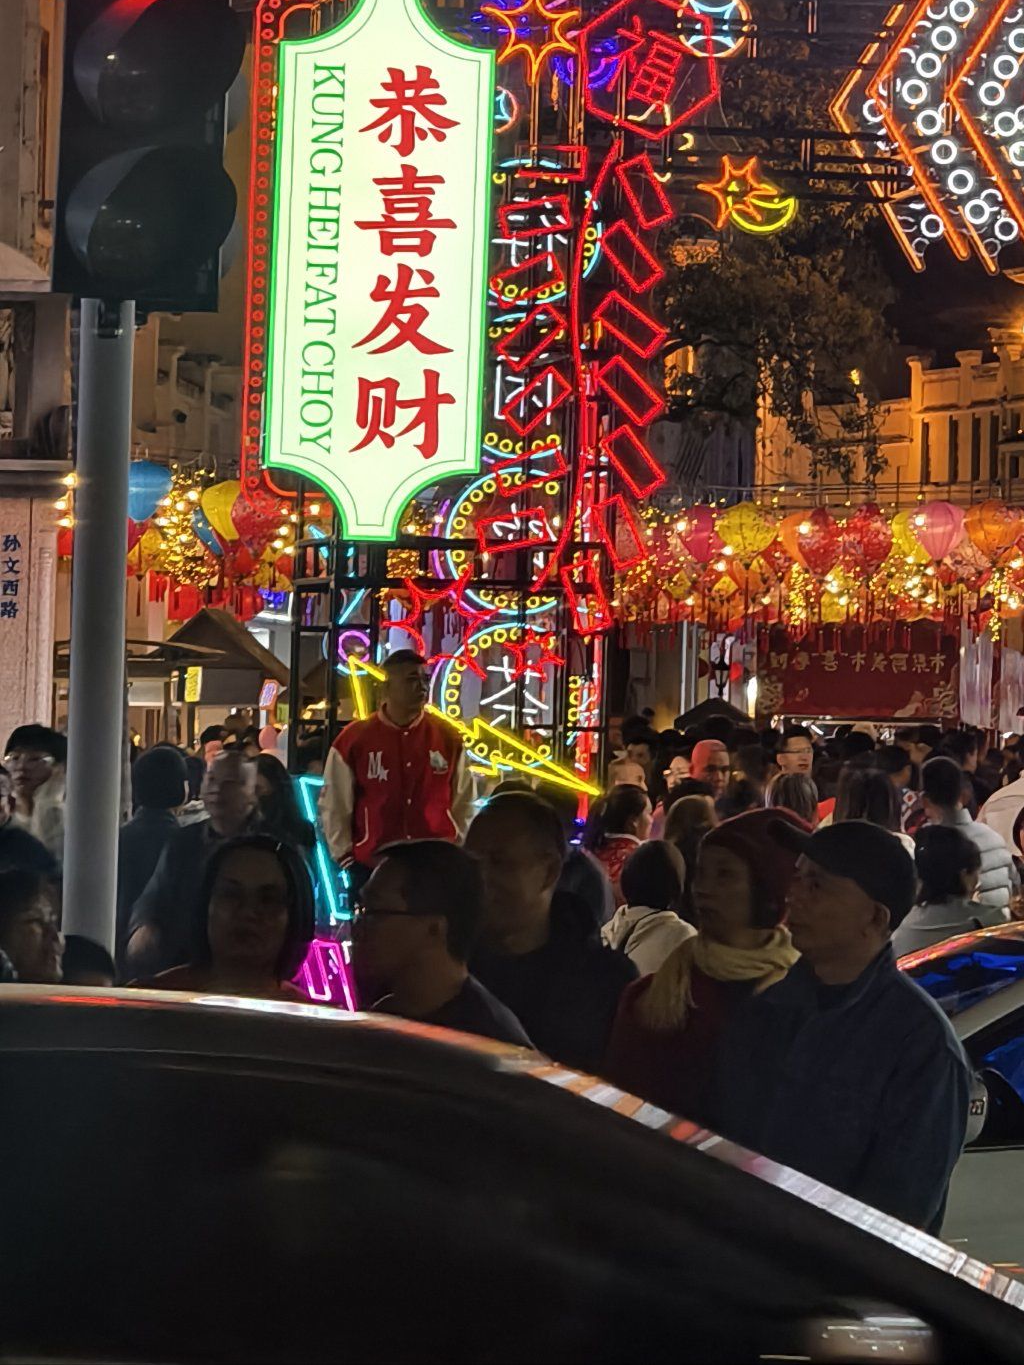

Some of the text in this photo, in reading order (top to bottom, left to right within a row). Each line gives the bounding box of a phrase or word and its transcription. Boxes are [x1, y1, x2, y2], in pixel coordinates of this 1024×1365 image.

[606, 15, 696, 113] 福
[299, 63, 346, 455] KUNG HEI FAT CHOY
[349, 65, 461, 460] 恭喜发财
[1, 534, 21, 619] 孙文西路
